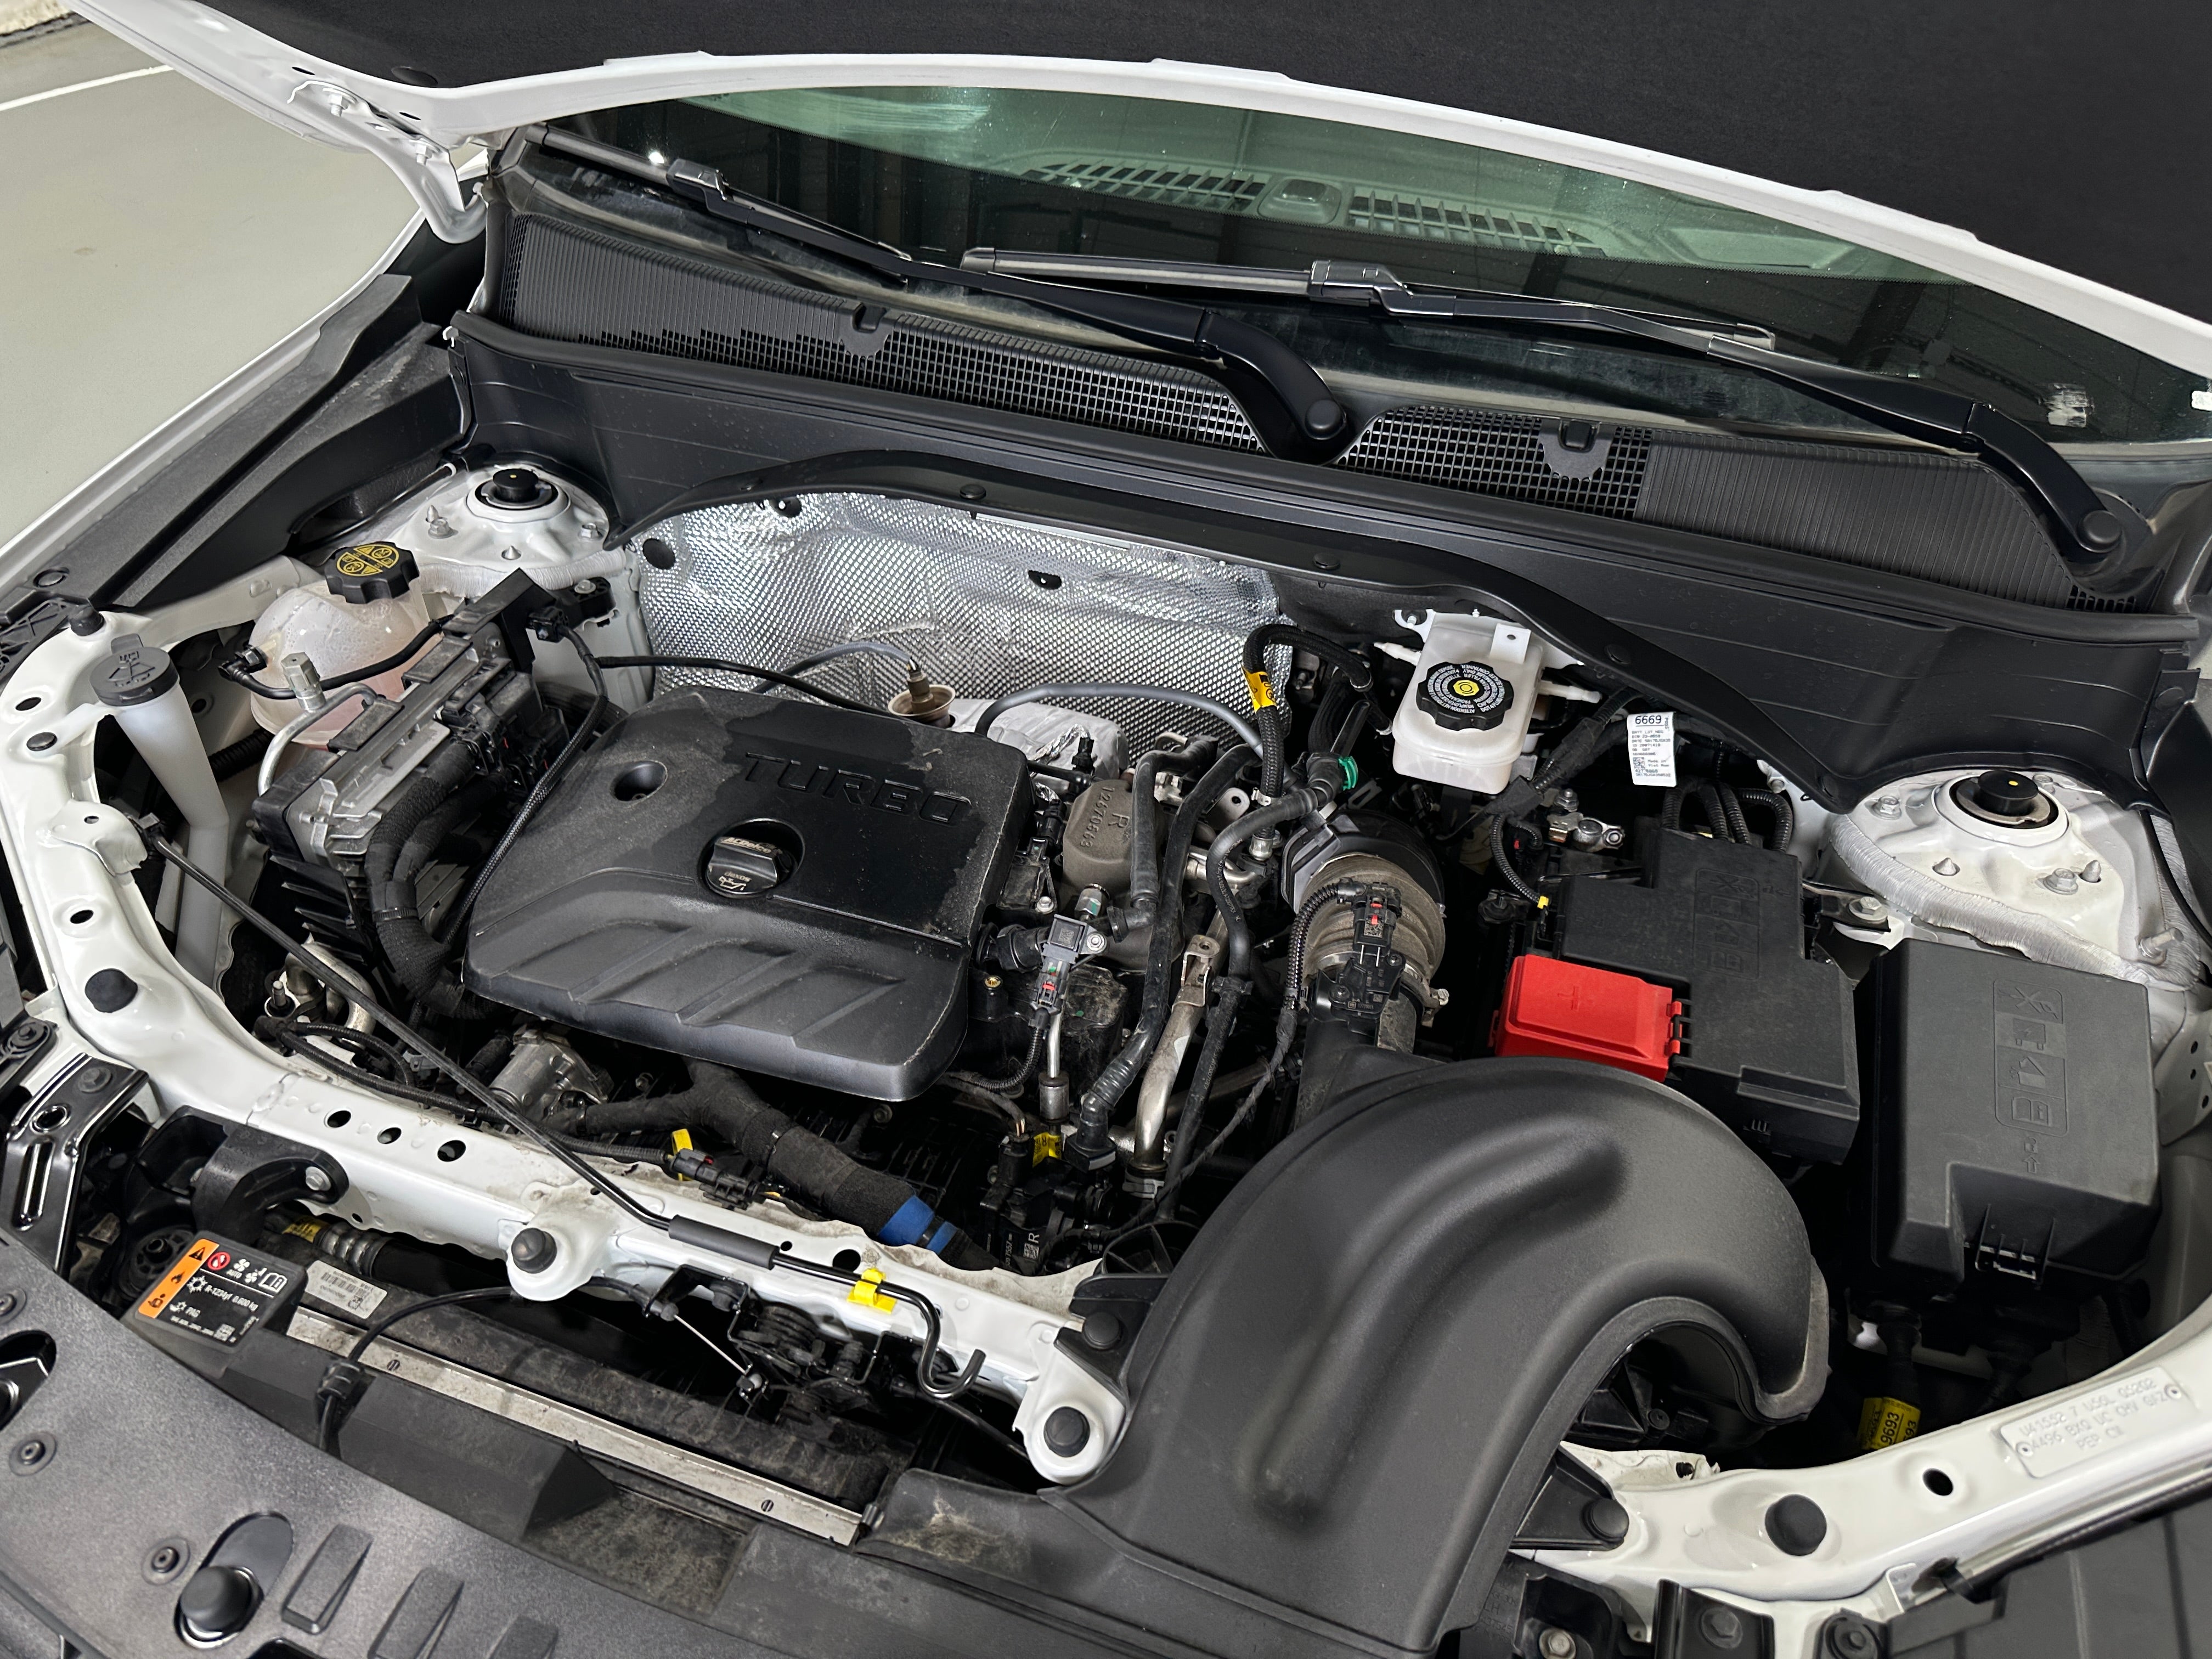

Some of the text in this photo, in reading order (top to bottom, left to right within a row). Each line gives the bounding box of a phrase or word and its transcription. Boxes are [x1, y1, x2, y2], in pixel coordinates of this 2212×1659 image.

[1635, 715, 1662, 725] 6669
[745, 752, 973, 826] TURBO
[1108, 813, 1130, 828] R
[721, 837, 772, 854] ACDelco
[1028, 1233, 1040, 1243] R
[185, 1306, 201, 1318] PAG
[1881, 1412, 1899, 1445] 9693
